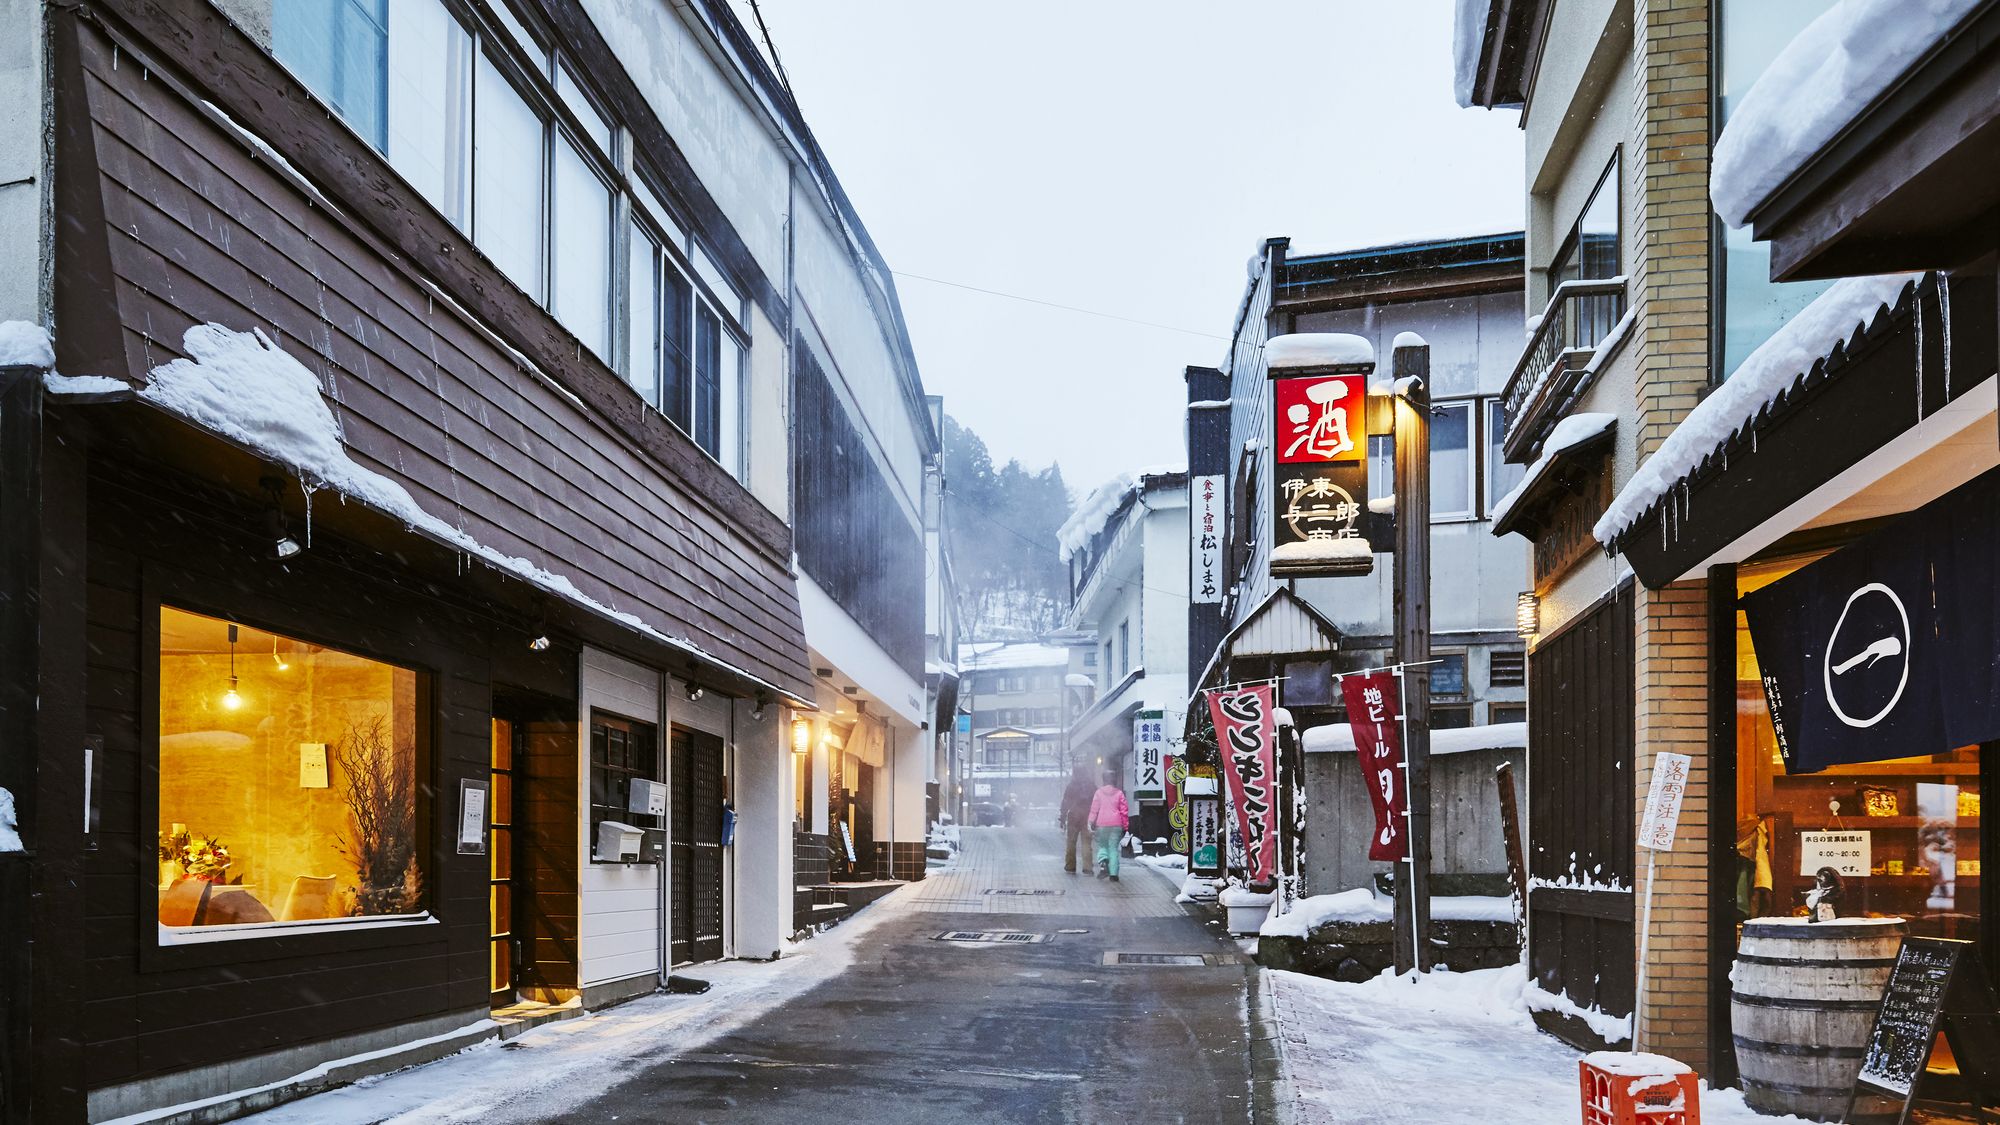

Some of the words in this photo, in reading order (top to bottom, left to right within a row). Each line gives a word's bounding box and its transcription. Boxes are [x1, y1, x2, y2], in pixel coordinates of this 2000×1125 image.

[1284, 380, 1355, 458] 酒
[1203, 479, 1214, 533] 食事と宿泊
[1281, 477, 1335, 499] 伊東
[1281, 501, 1360, 525] 与三郎
[1200, 534, 1217, 599] 松しまや
[1363, 687, 1390, 759] 地ビール
[1143, 748, 1159, 786] 利久
[1653, 760, 1686, 846] 落雪注意
